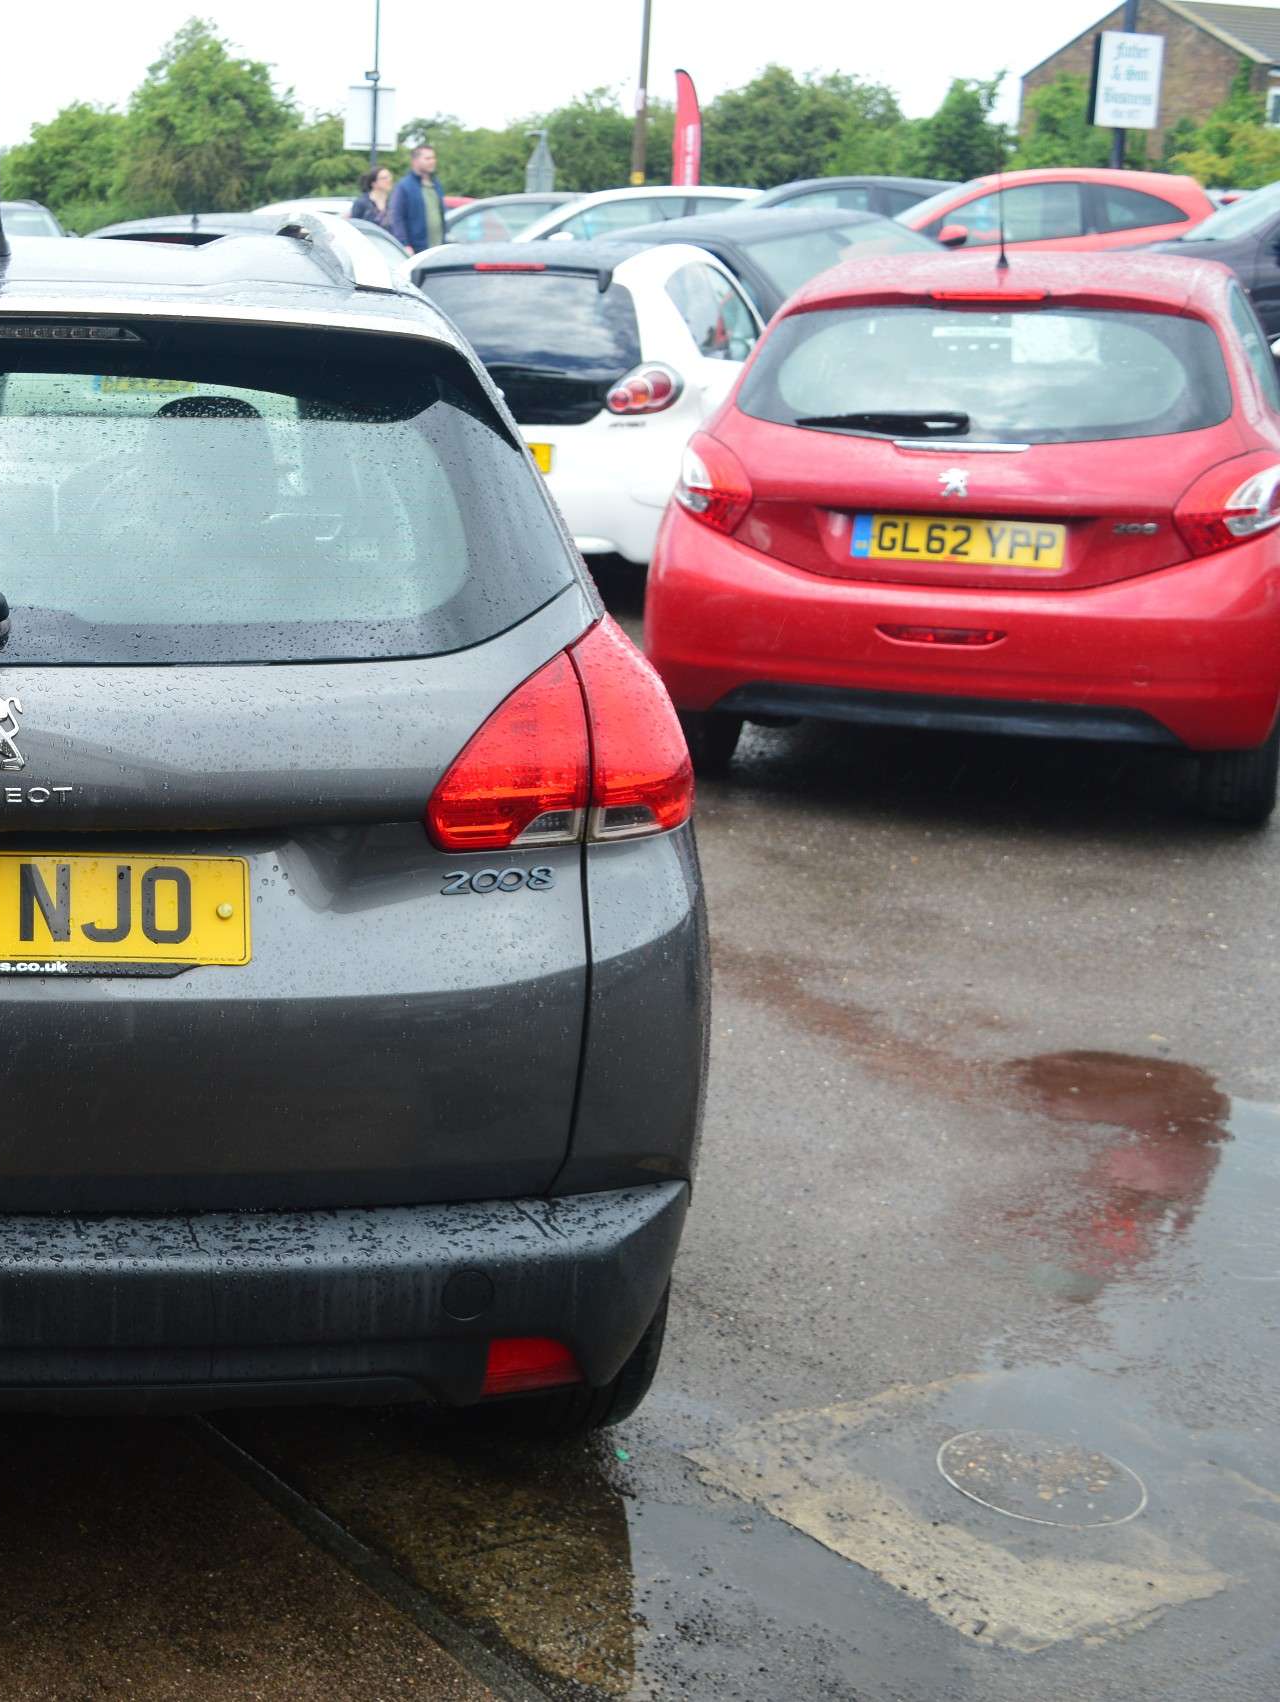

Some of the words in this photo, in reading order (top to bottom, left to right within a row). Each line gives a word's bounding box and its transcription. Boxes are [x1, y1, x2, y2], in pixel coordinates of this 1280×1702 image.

[877, 521, 971, 556] GL62
[986, 526, 1056, 561] YPP
[440, 865, 556, 896] 2008
[19, 863, 192, 944] NJO
